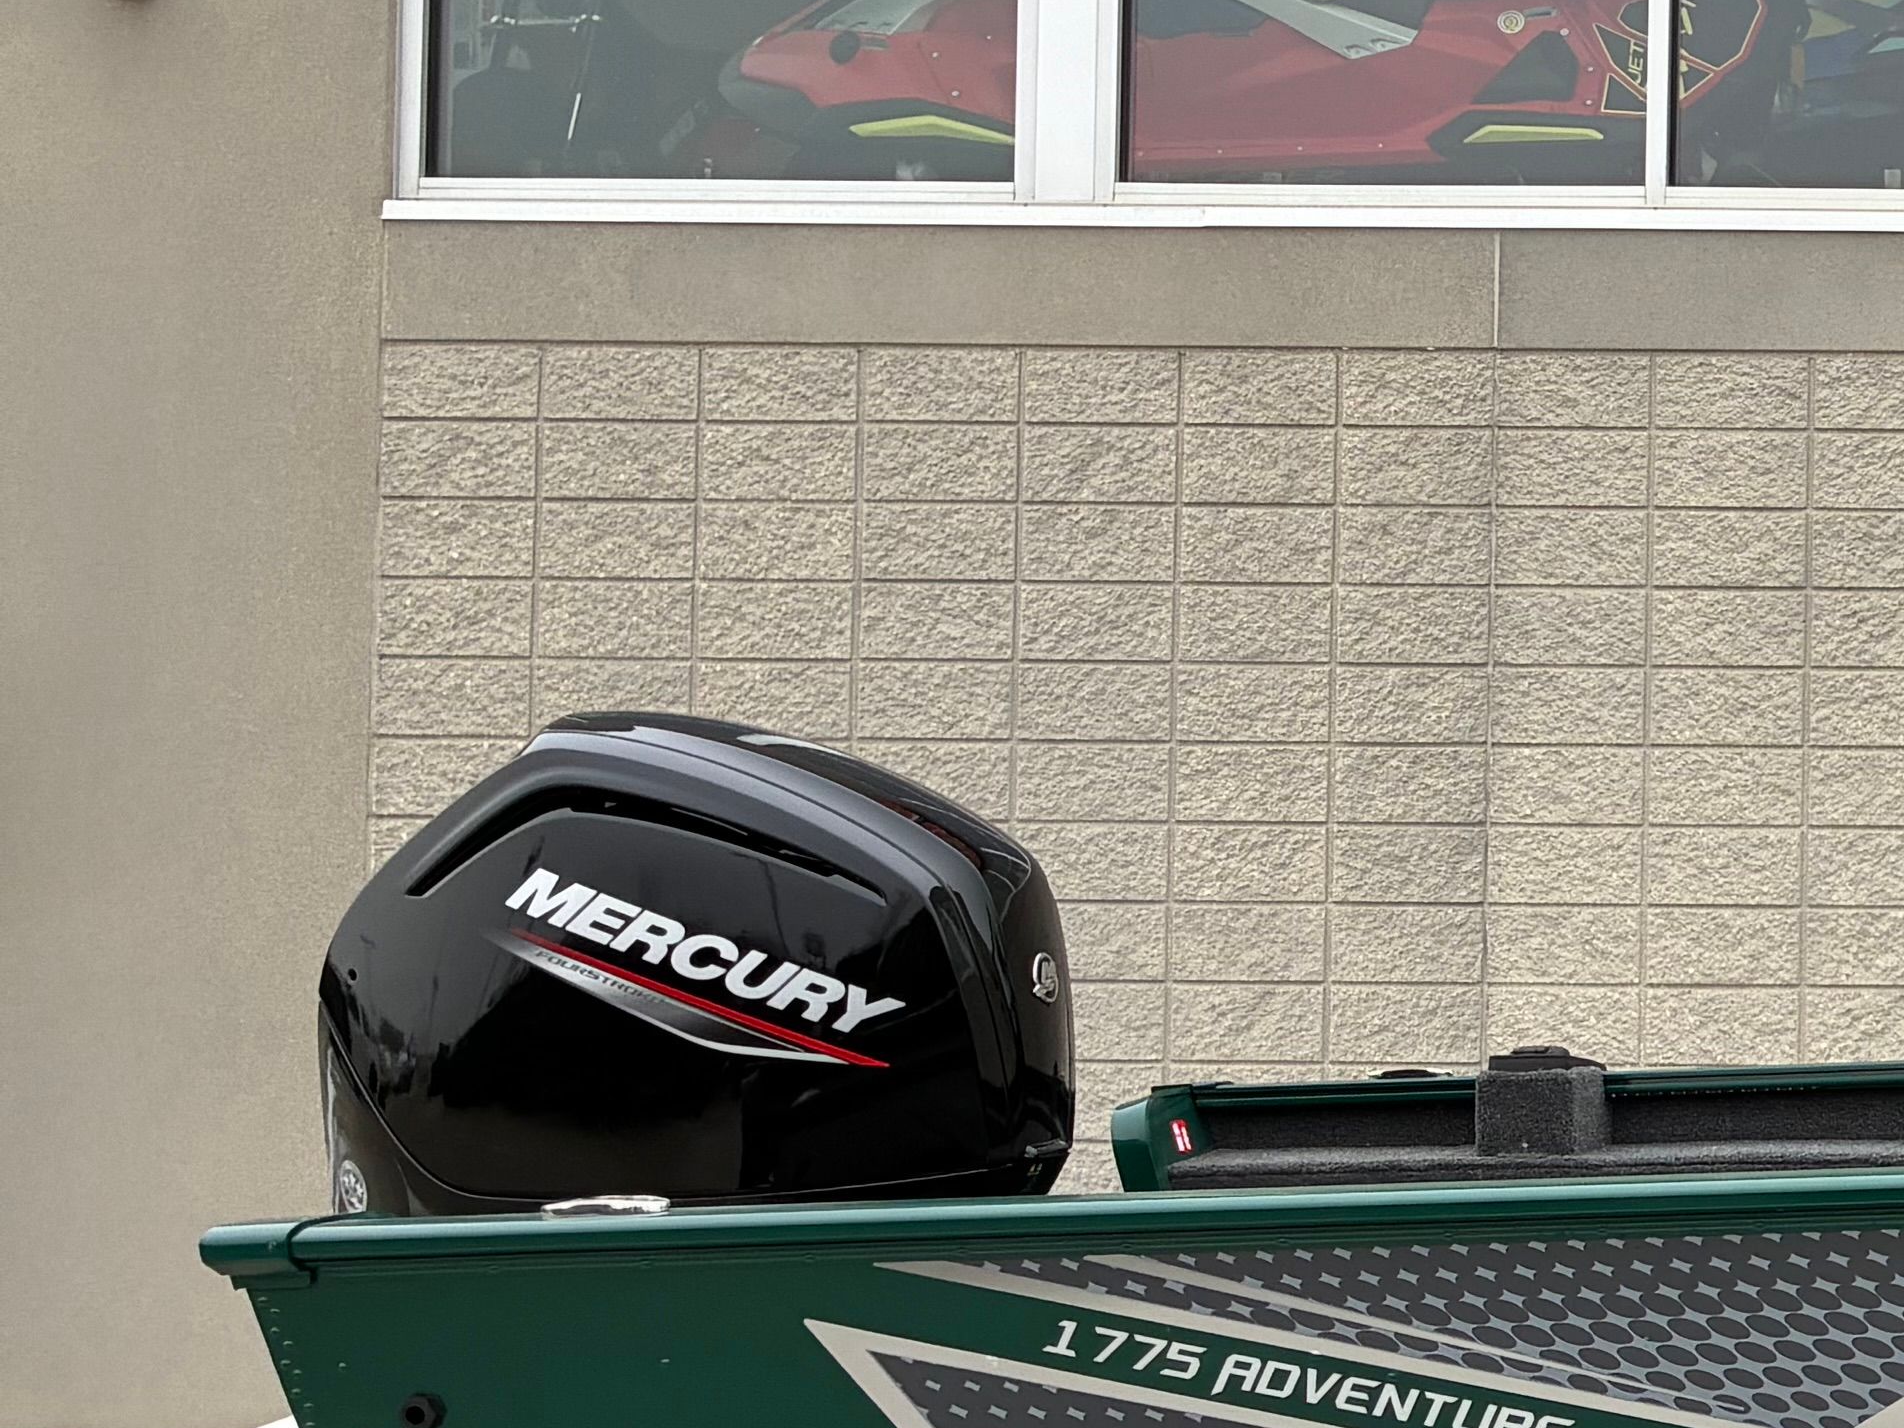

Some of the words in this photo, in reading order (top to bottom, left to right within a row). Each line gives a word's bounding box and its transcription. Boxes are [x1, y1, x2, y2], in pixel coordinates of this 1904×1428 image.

[1627, 40, 1646, 85] JET
[505, 868, 907, 1033] MERCURY
[1042, 1319, 1208, 1380] 1775
